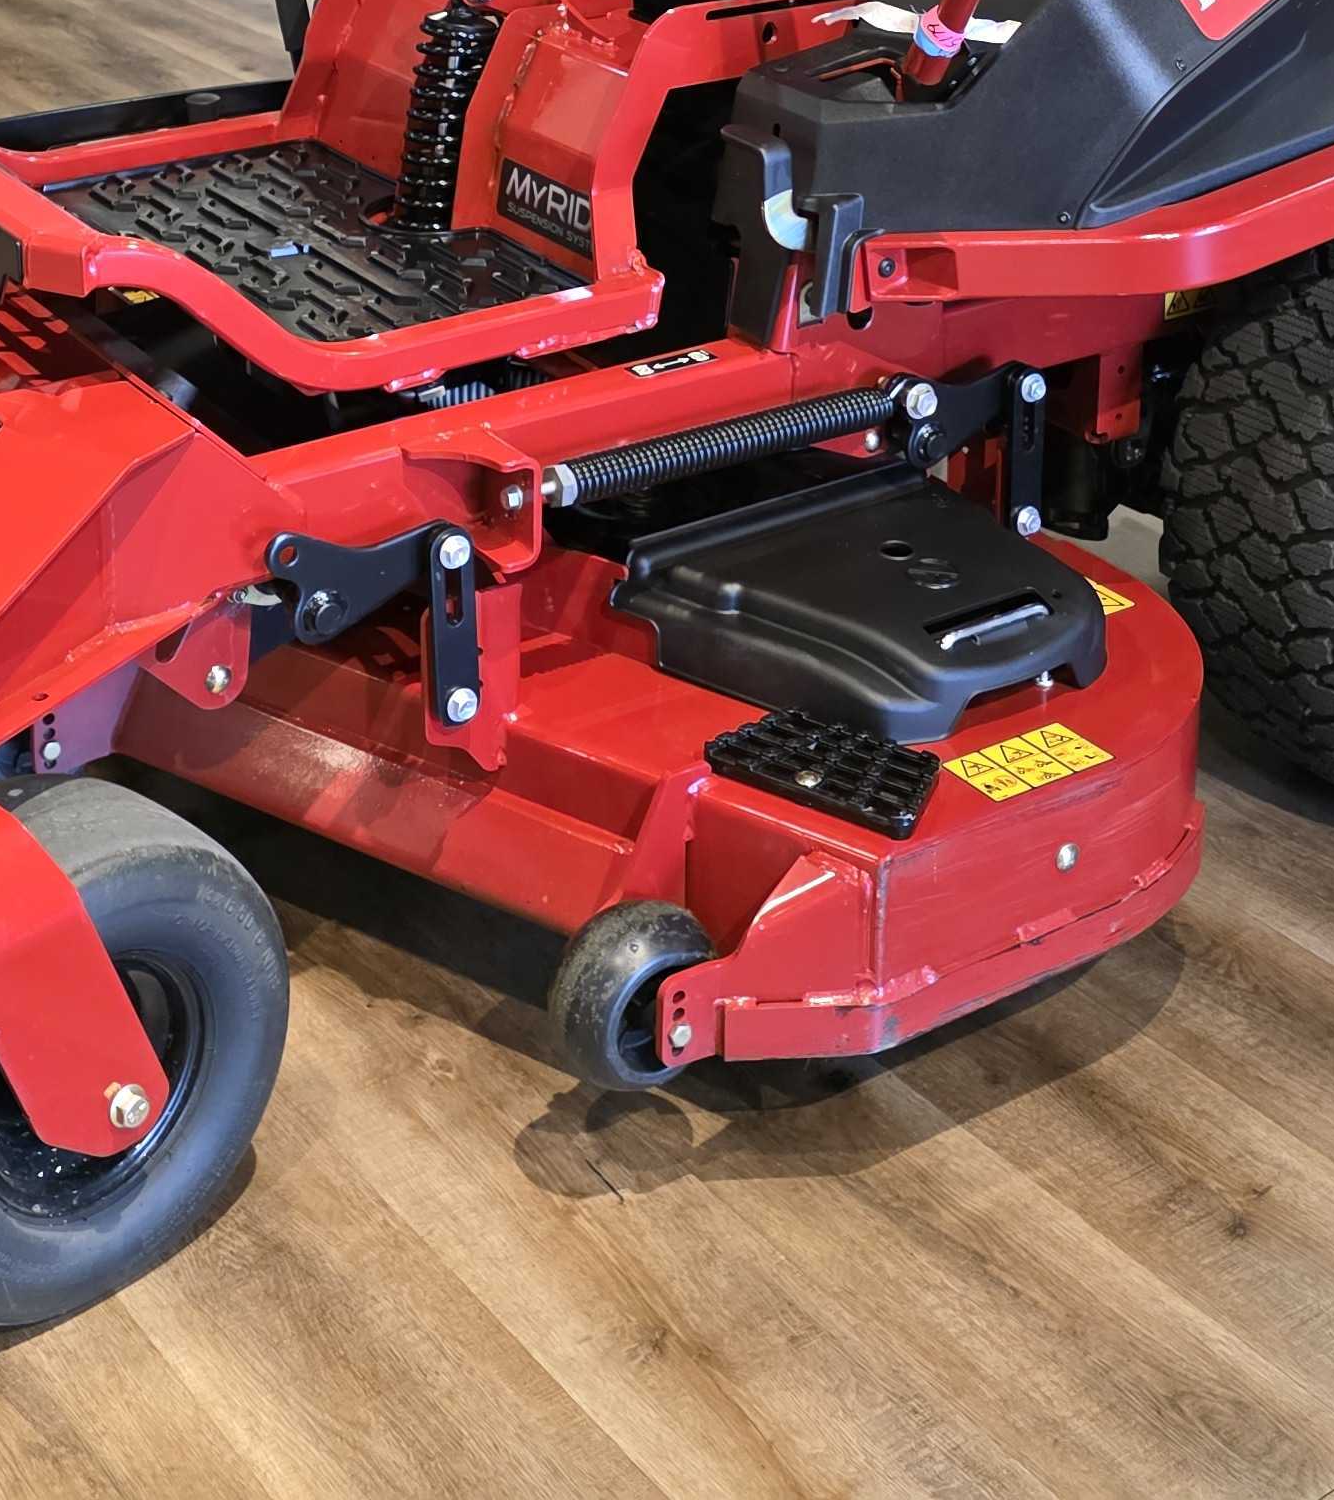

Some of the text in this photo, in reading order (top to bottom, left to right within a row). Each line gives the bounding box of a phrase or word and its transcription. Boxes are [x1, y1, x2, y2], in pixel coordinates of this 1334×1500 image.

[505, 167, 592, 232] MyRID
[506, 201, 591, 249] SUSPENSION SYST
